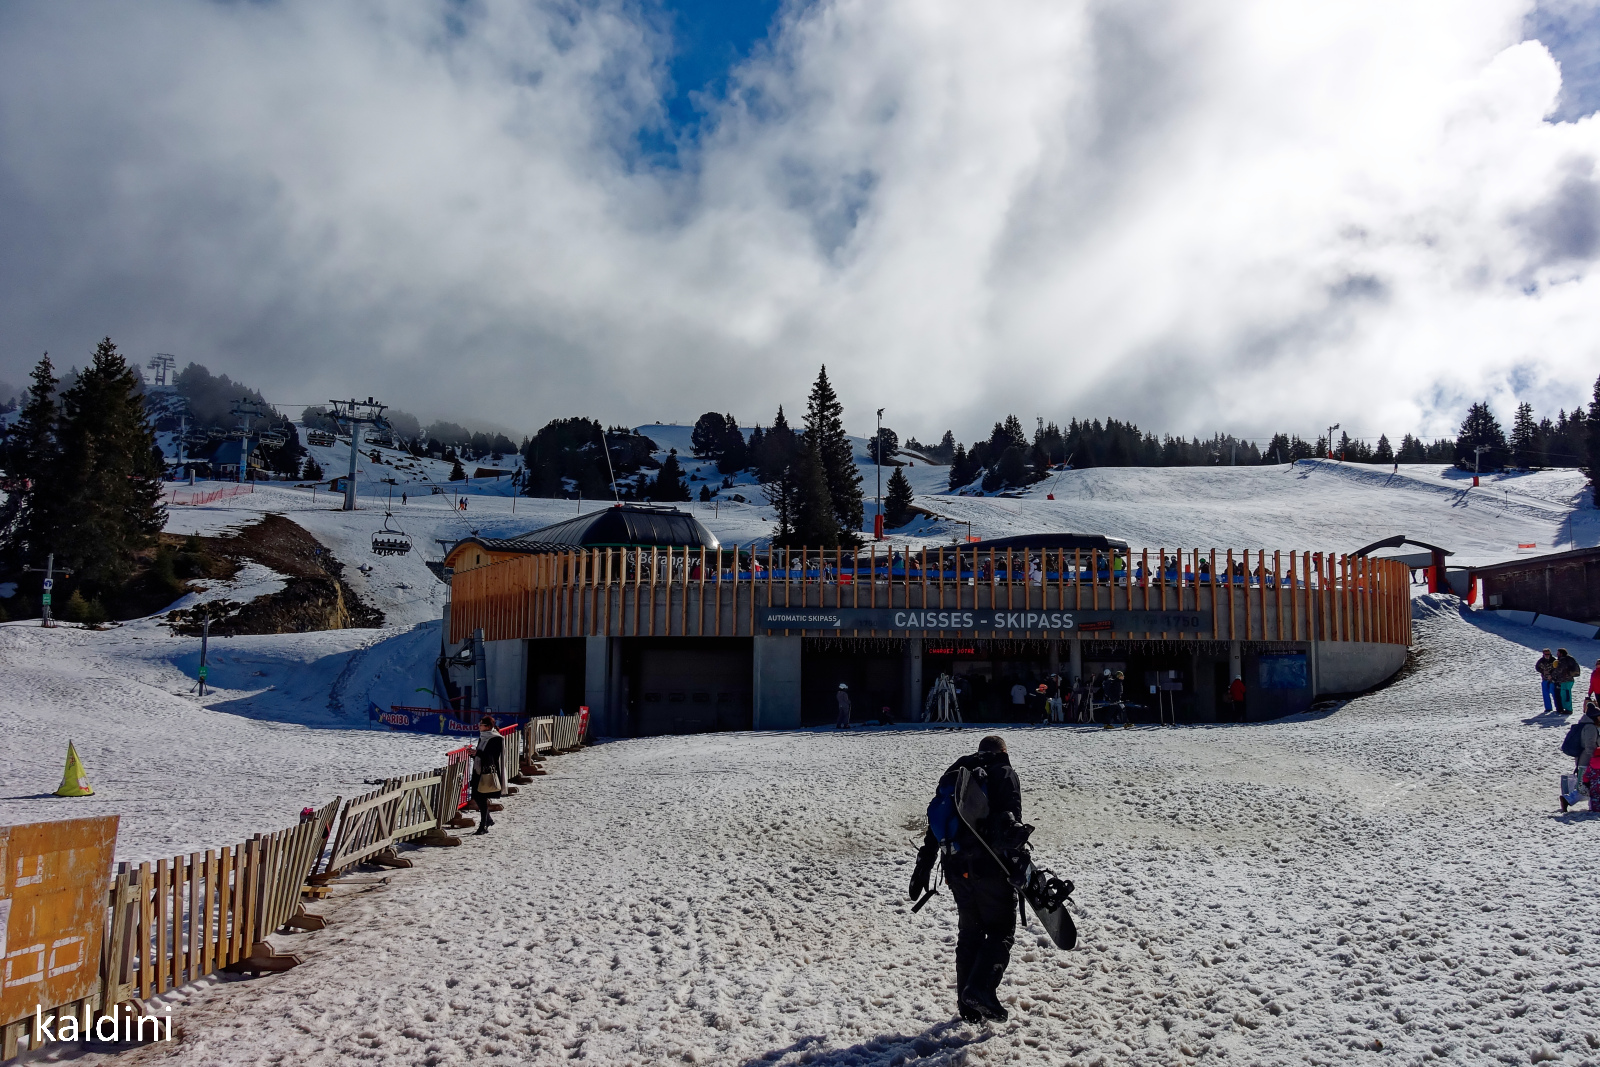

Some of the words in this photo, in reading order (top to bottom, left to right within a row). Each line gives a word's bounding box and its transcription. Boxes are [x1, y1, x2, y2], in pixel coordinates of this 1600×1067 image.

[808, 615, 837, 623] SKIPASS
[894, 612, 974, 629] CAISSES
[994, 612, 1075, 629] SKIPASS
[1164, 616, 1199, 628] 1750
[381, 713, 410, 726] HARIBO
[448, 719, 480, 732] HARIB
